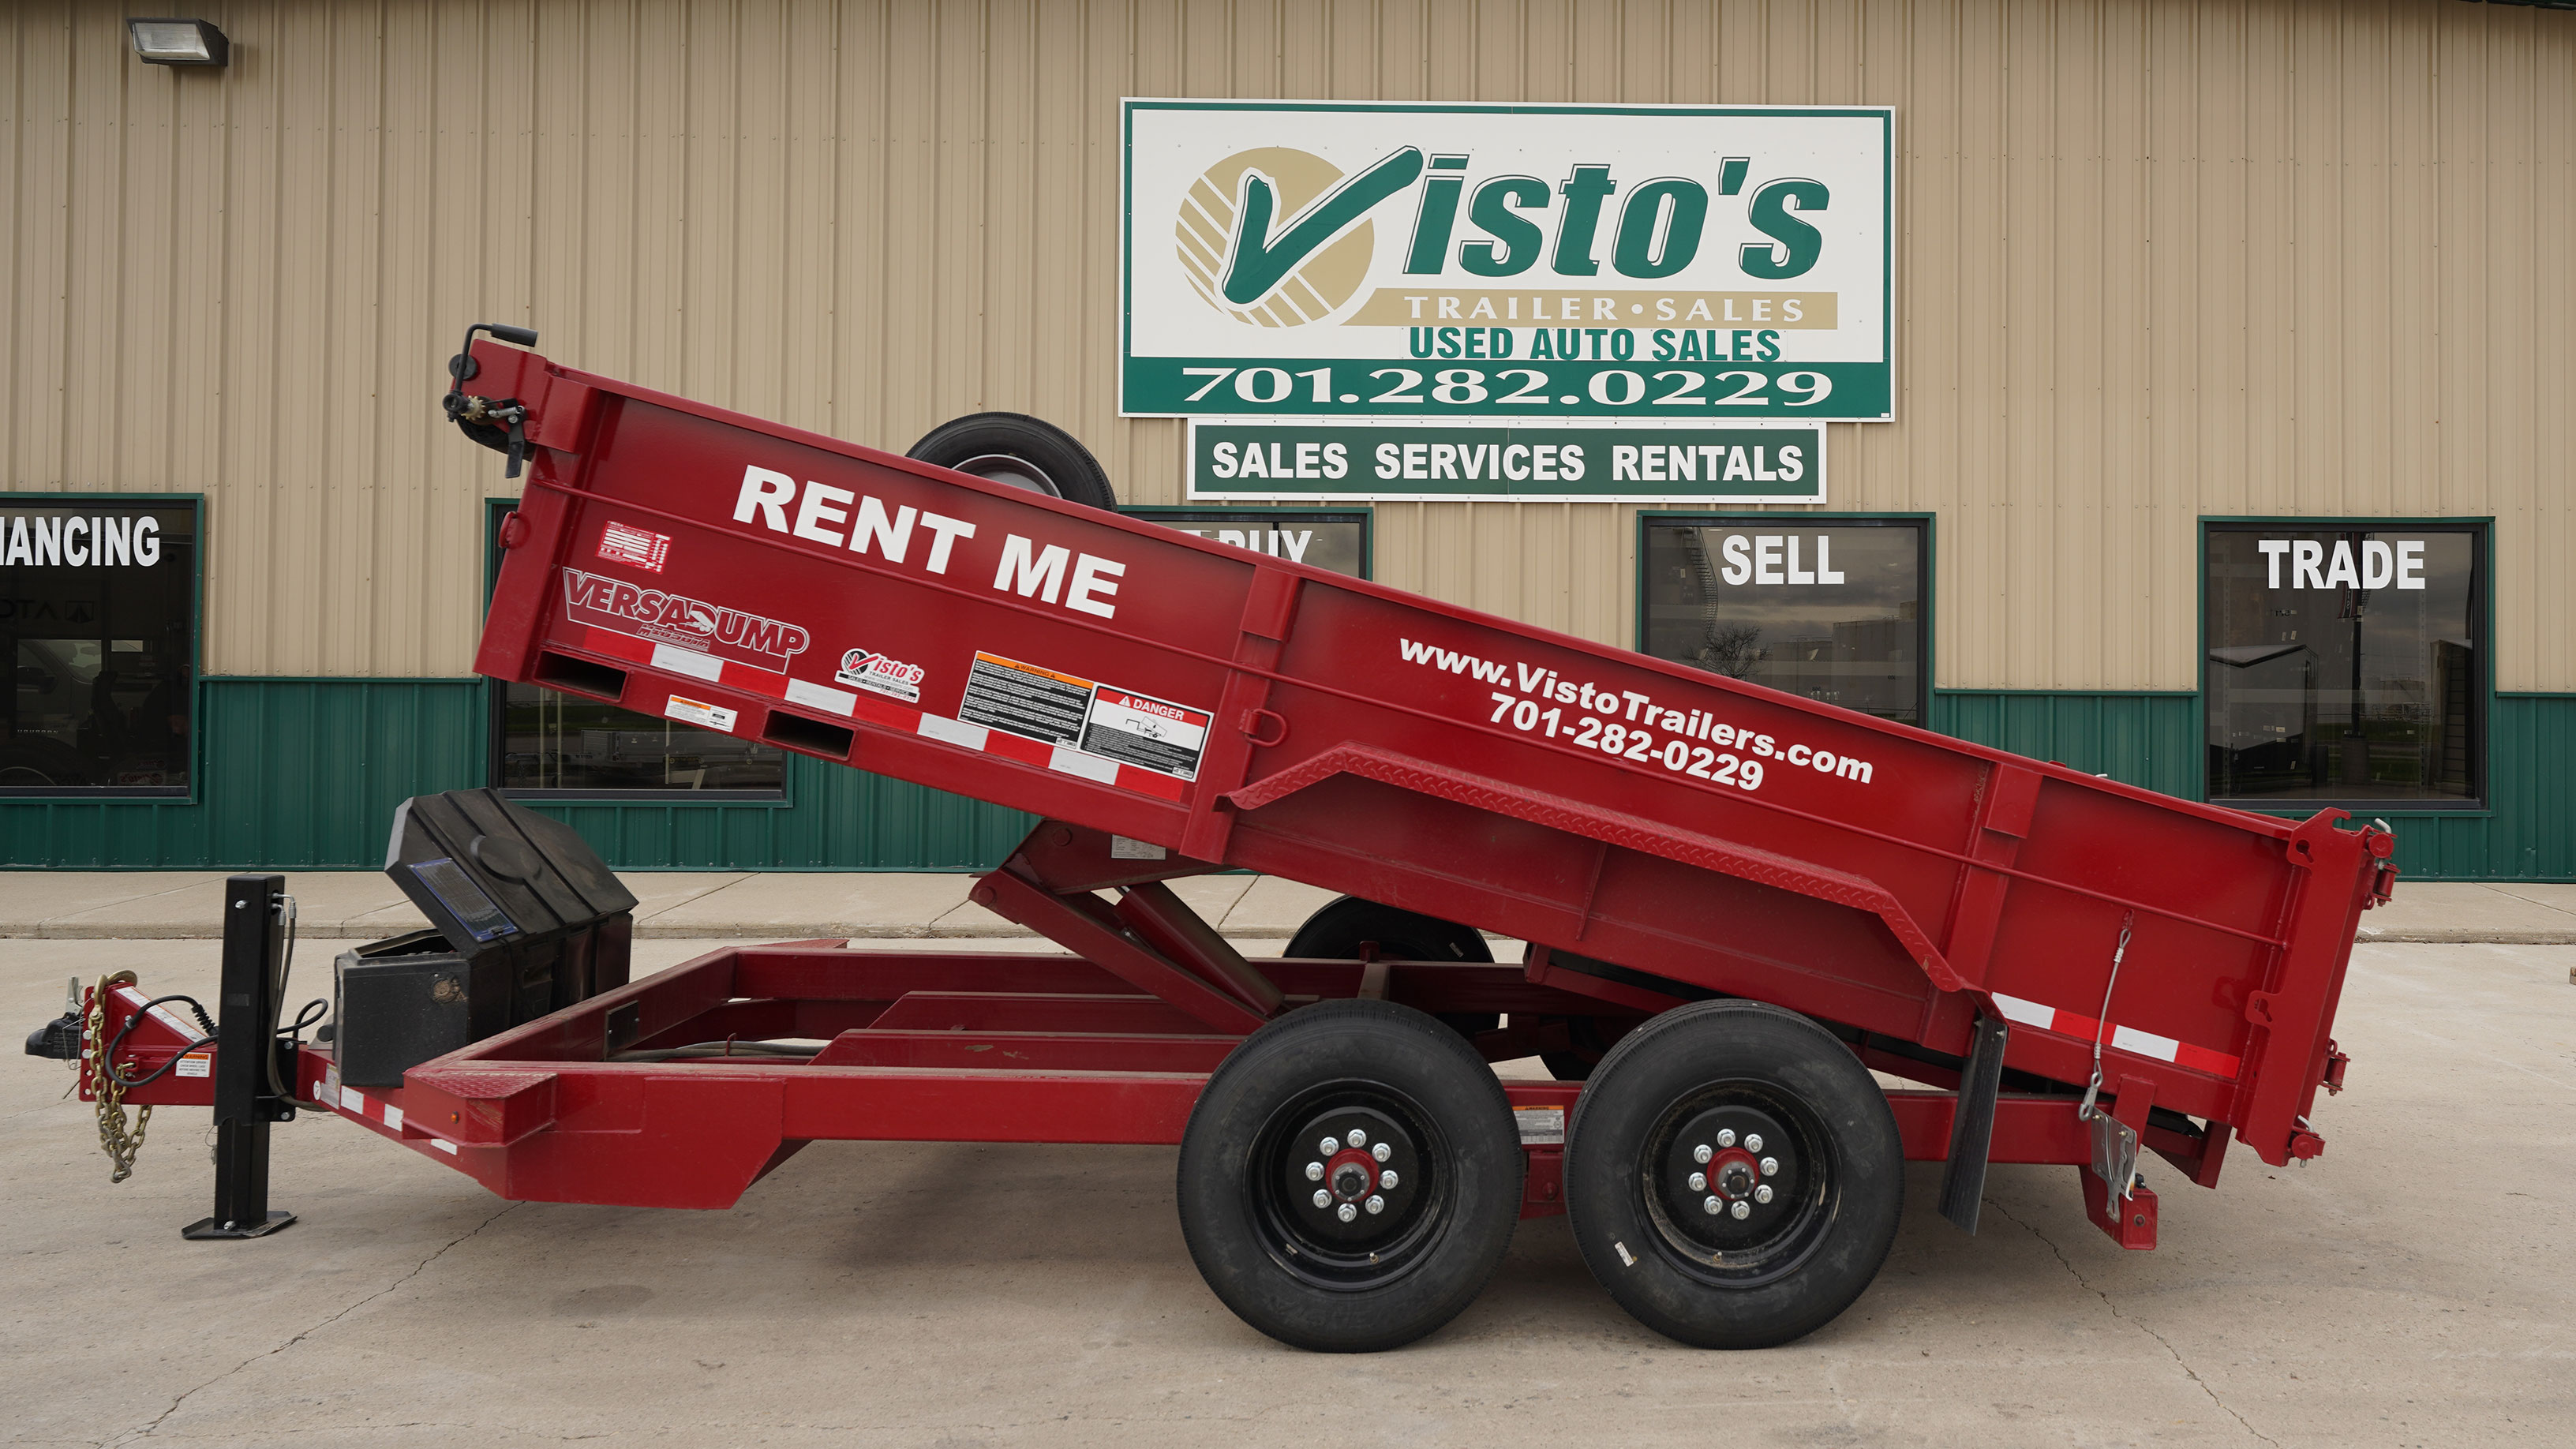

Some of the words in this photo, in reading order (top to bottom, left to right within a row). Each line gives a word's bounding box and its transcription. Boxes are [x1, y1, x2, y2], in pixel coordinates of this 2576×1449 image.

[1222, 145, 1829, 304] Visto's
[1403, 296, 1619, 320] TRAILER
[1656, 298, 1803, 323] SALES
[1410, 327, 1513, 359] USED
[1530, 328, 1634, 361] AUTO
[1652, 328, 1780, 362] SALES
[1182, 367, 1833, 406] 701.282.0229
[1211, 441, 1349, 479] SALES
[1374, 443, 1586, 481] SERVICES
[1612, 445, 1803, 482] RENTALS
[0, 515, 160, 567] ANCING
[732, 464, 976, 575] RENT
[993, 533, 1126, 620] ME
[1721, 534, 1845, 586] SELL
[2258, 540, 2425, 590] TRADE
[848, 653, 922, 682] Visto's
[1020, 665, 1050, 676] WARNING
[1133, 697, 1185, 721] DANGER
[1399, 638, 1874, 784] www.VistoTrailers.com
[1489, 691, 1764, 791] 701-282-0229
